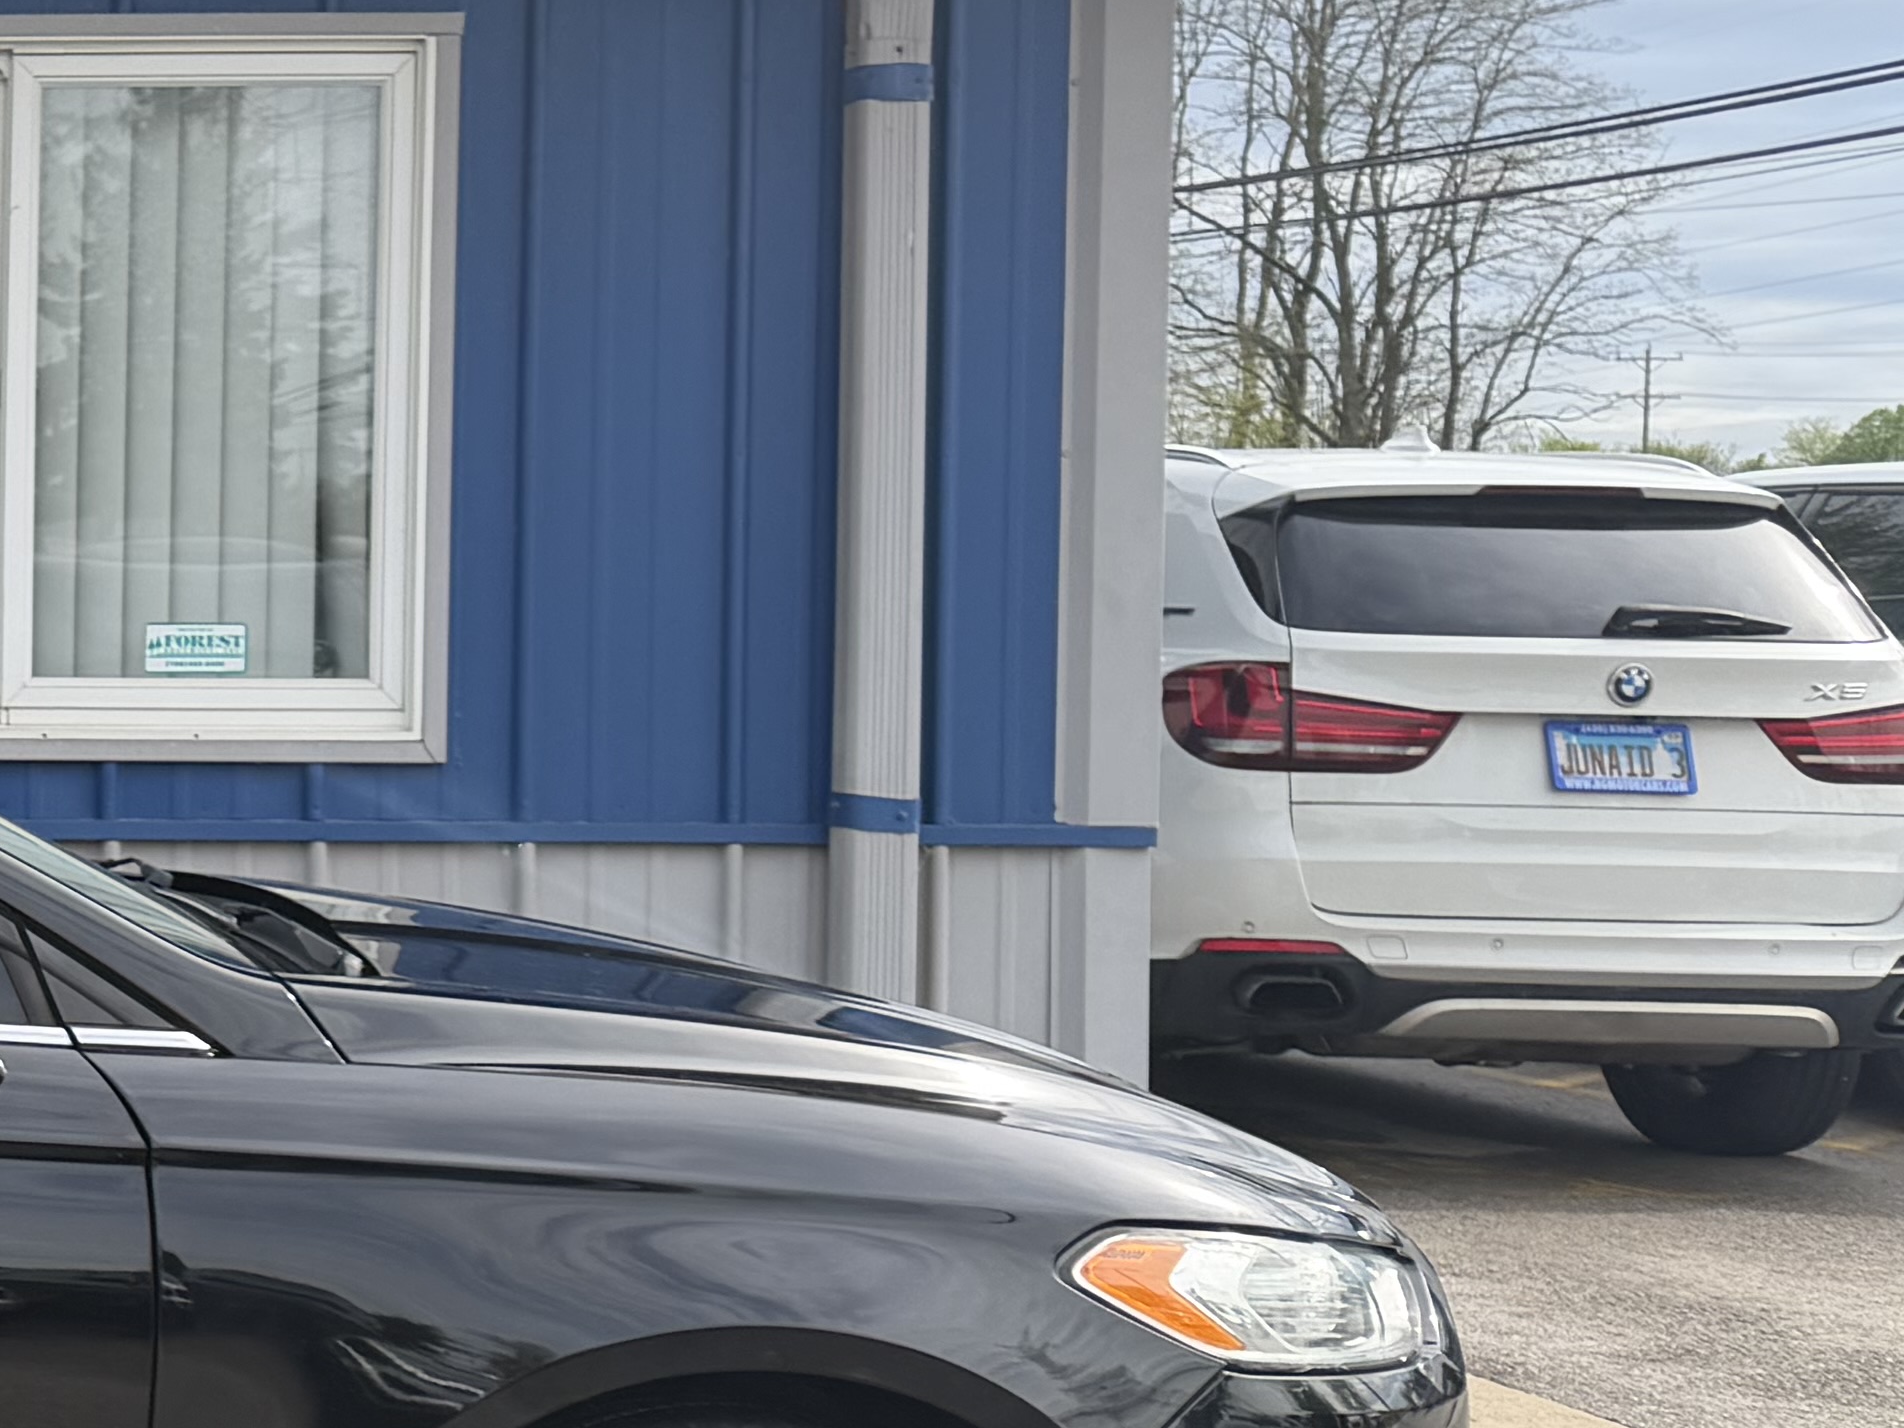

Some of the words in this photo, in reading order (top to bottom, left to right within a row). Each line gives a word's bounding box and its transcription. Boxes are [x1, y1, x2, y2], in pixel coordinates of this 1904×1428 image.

[164, 634, 244, 648] FOREST
[1803, 682, 1869, 703] X5
[1561, 742, 1655, 777] JUNAID
[1671, 746, 1687, 779] 3
